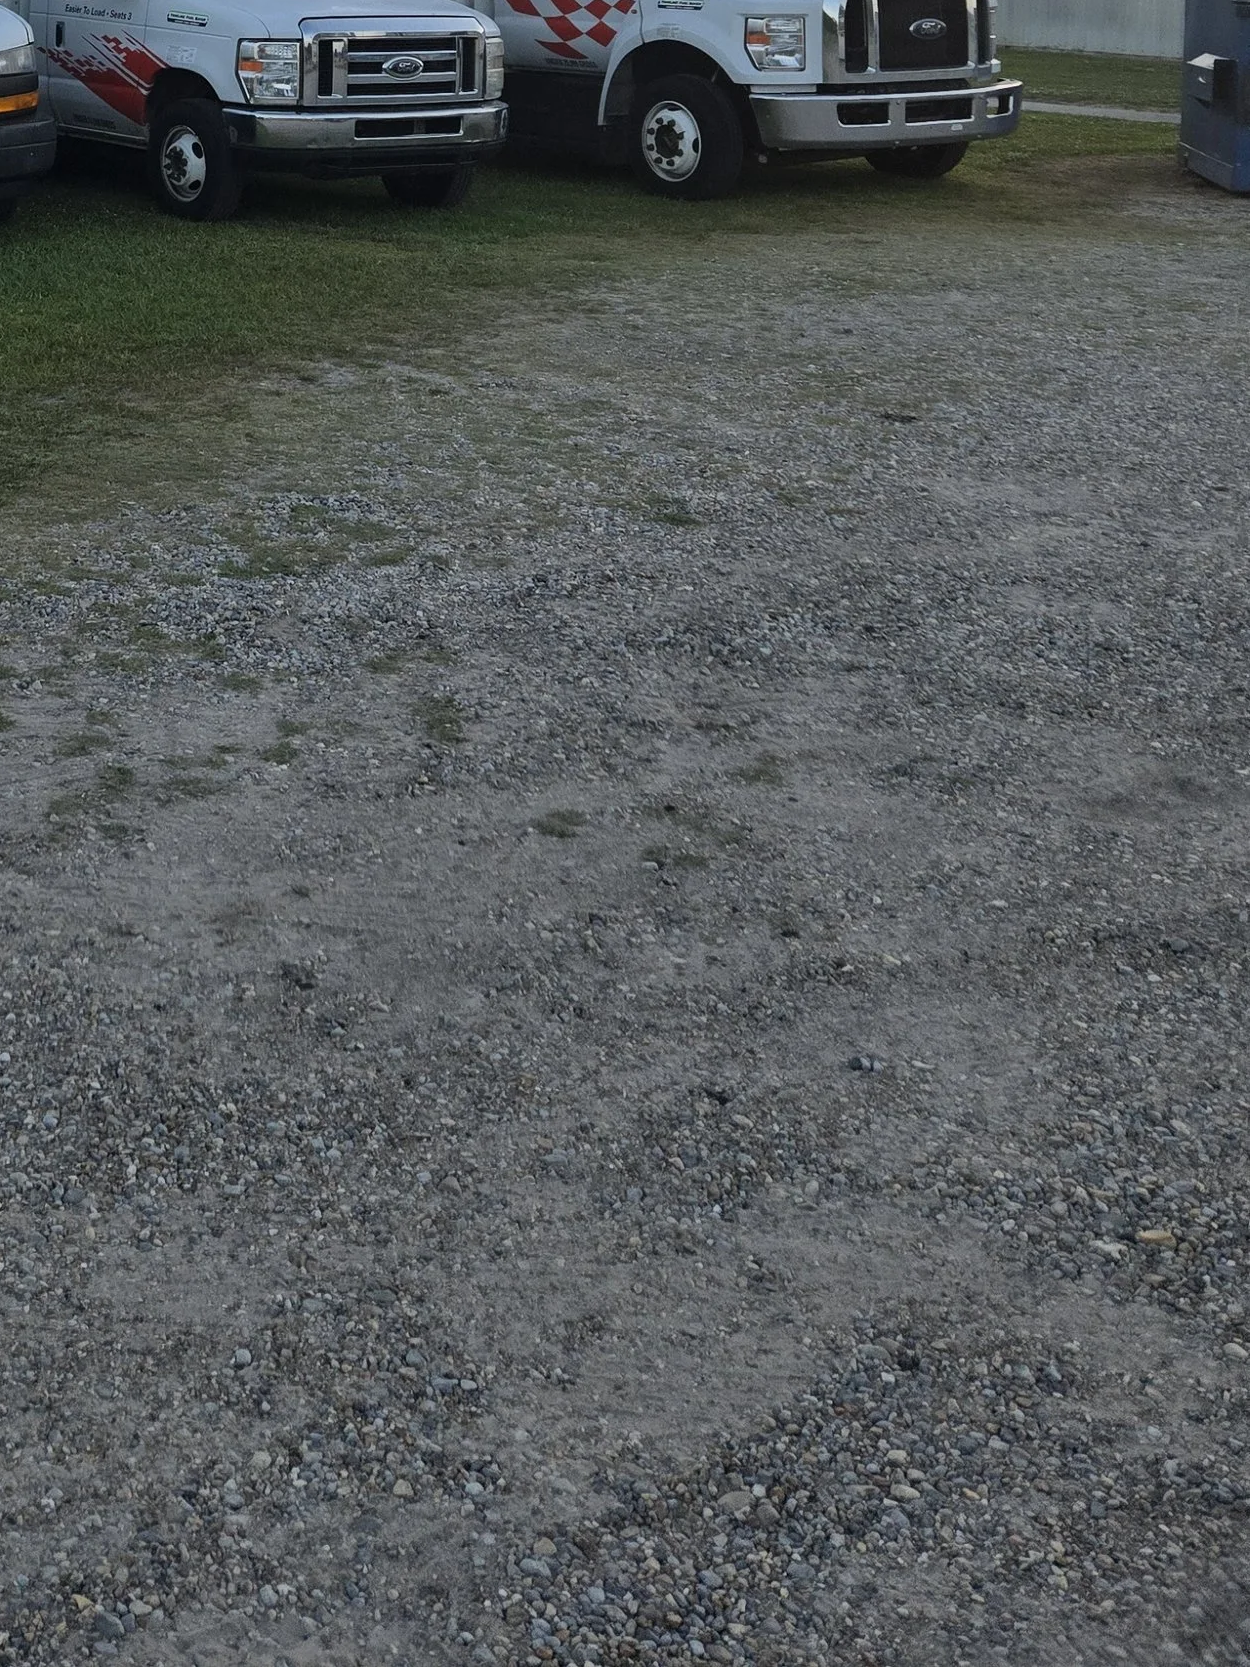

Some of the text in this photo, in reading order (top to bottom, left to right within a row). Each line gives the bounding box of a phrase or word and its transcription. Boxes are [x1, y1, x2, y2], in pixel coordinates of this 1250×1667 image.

[65, 3, 132, 21] Easier To Load Seats 3
